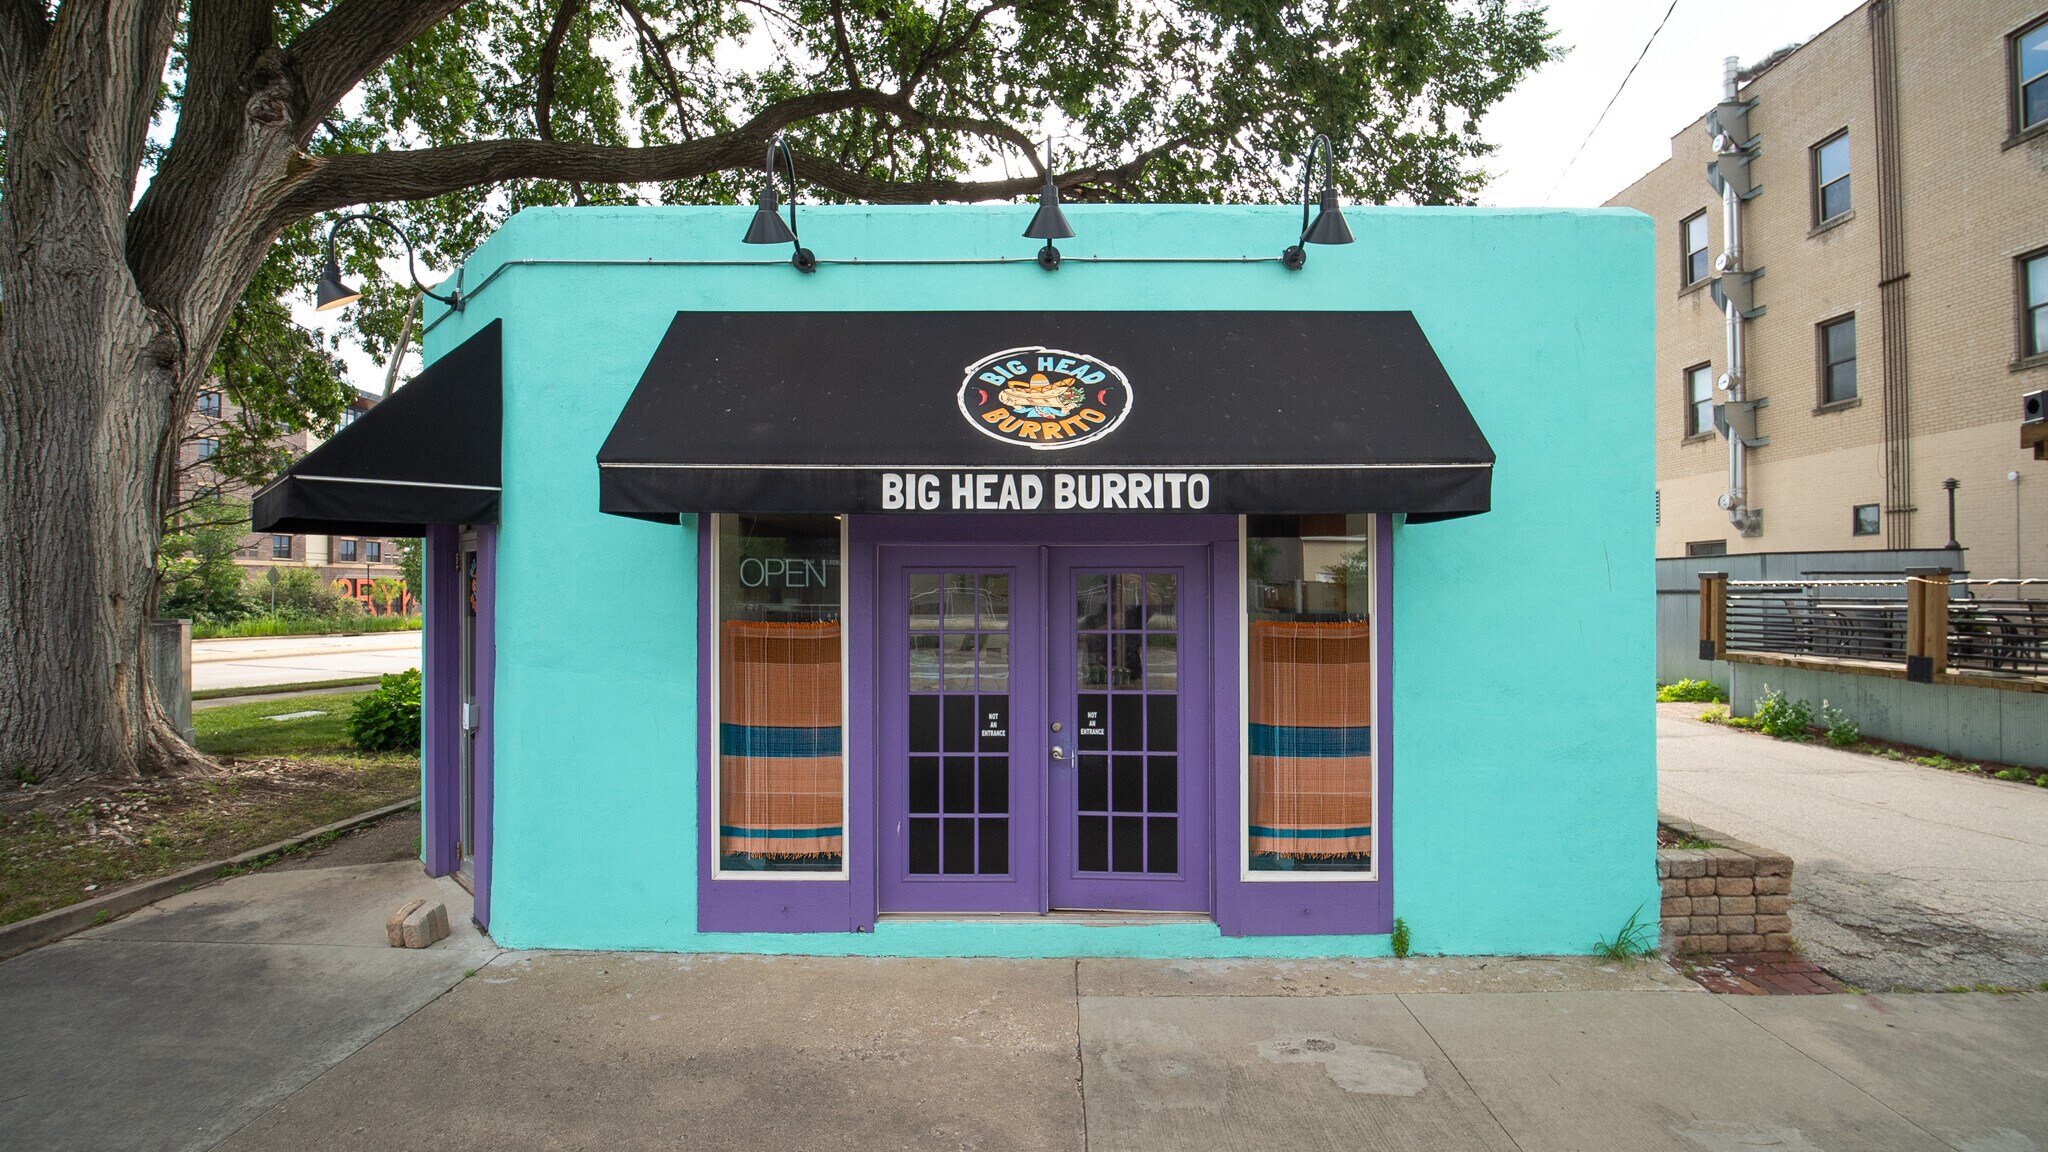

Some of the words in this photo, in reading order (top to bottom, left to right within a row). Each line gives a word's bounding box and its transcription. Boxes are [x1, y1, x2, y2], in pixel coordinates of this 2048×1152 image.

[979, 360, 1028, 387] BIG
[1037, 356, 1106, 385] HEAD
[981, 407, 1107, 440] BURRITO
[882, 473, 941, 510] BIG
[951, 473, 1044, 510] HEAD
[1054, 472, 1211, 510] BURRITO
[740, 557, 827, 588] OPEN
[988, 712, 999, 720] NOT
[1087, 711, 1098, 719] NOT
[981, 729, 1006, 737] ENTRANCE
[989, 721, 998, 729] AN
